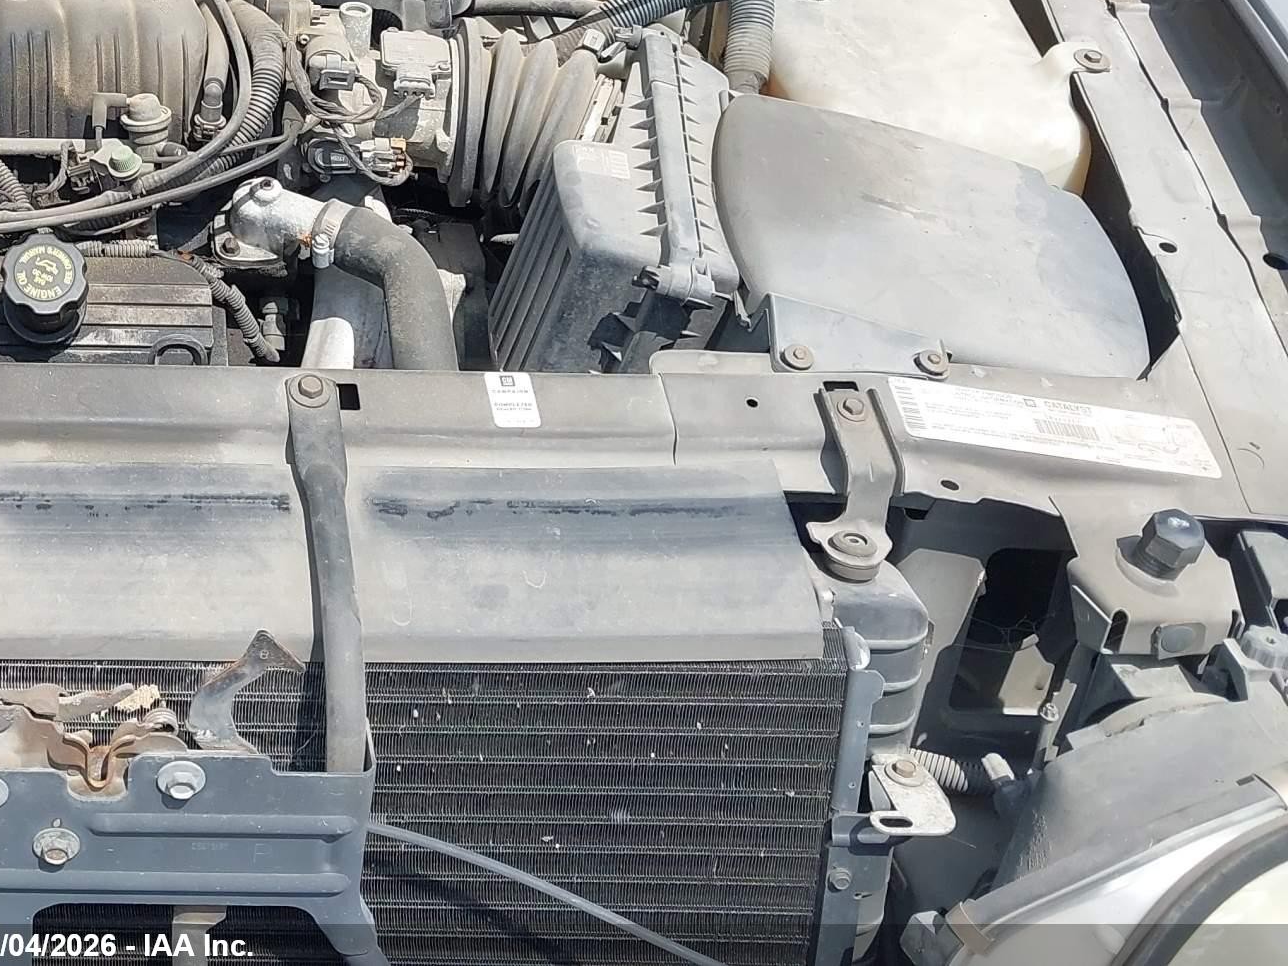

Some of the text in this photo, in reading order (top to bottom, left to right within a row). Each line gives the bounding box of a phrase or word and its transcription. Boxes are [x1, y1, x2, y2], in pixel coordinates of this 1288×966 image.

[17, 270, 62, 298] ENGINE OIL
[1044, 400, 1092, 416] CATALYST
